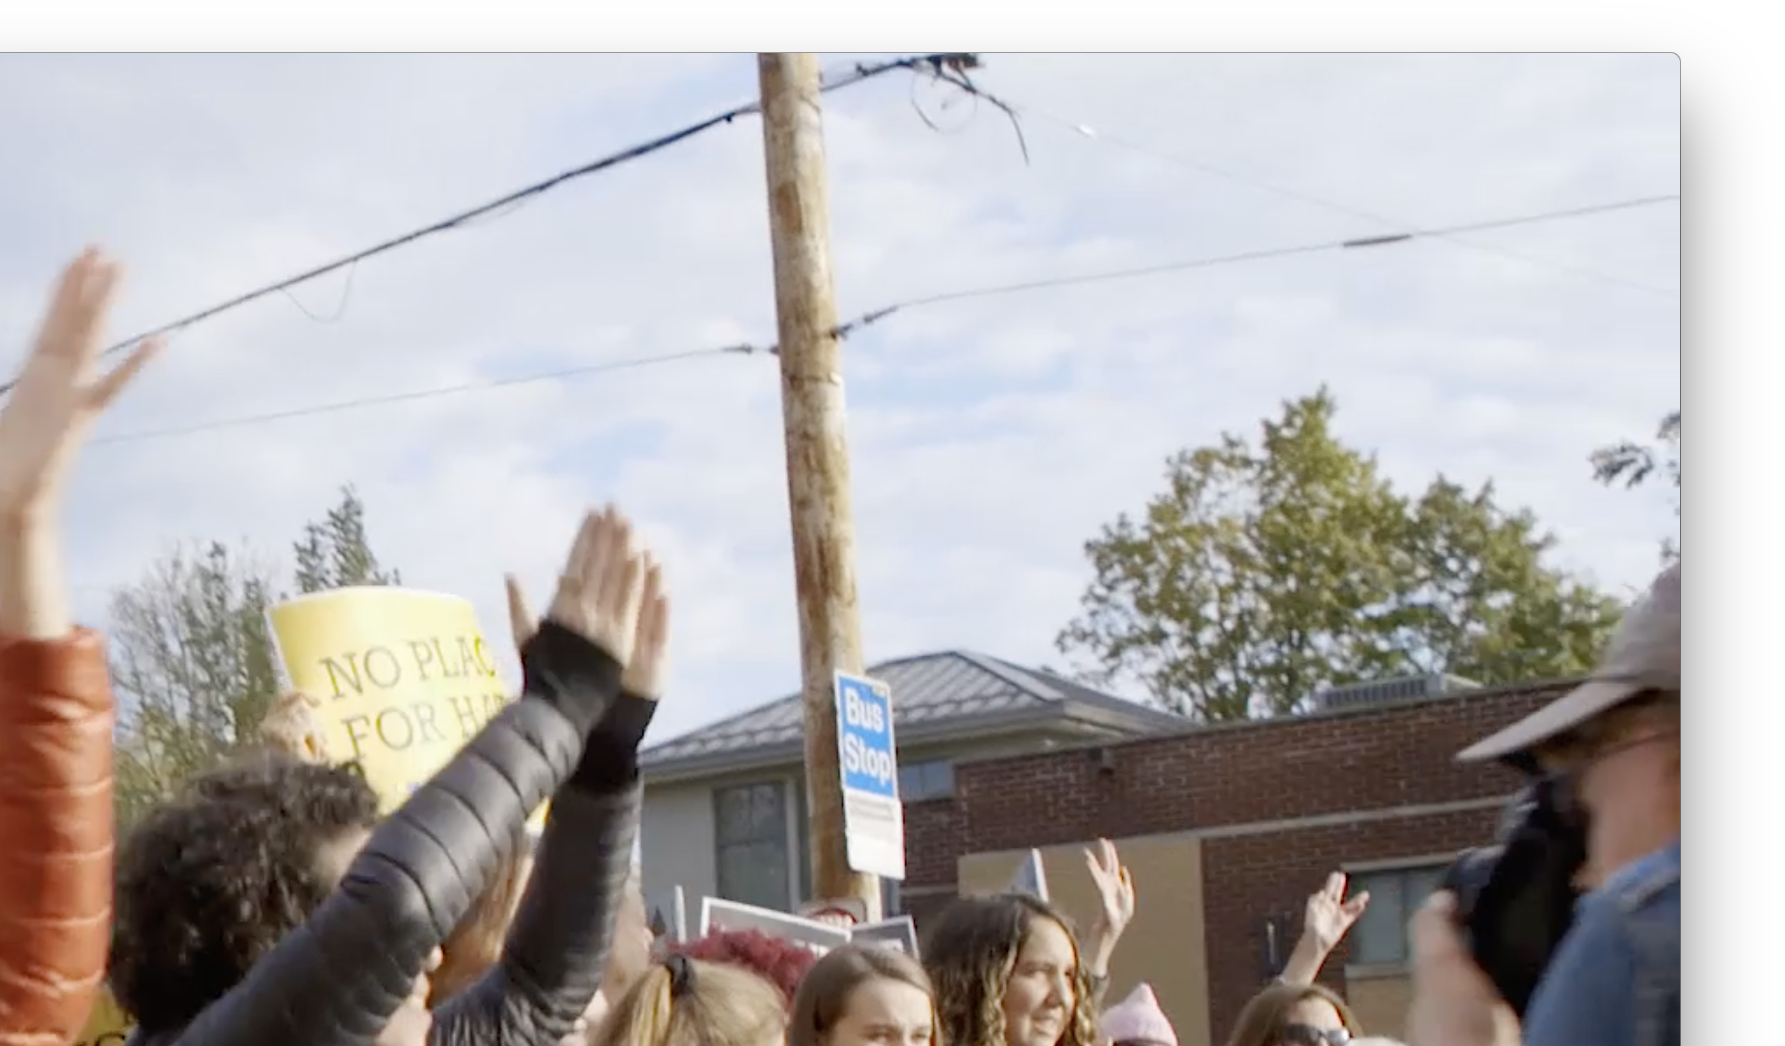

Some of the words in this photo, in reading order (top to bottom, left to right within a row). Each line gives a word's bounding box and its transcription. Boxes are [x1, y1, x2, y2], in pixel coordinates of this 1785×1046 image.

[320, 645, 402, 700] NO
[406, 634, 496, 682] PLAC
[341, 700, 447, 758] FOR
[843, 685, 885, 735] Bus
[844, 731, 891, 787] Stop
